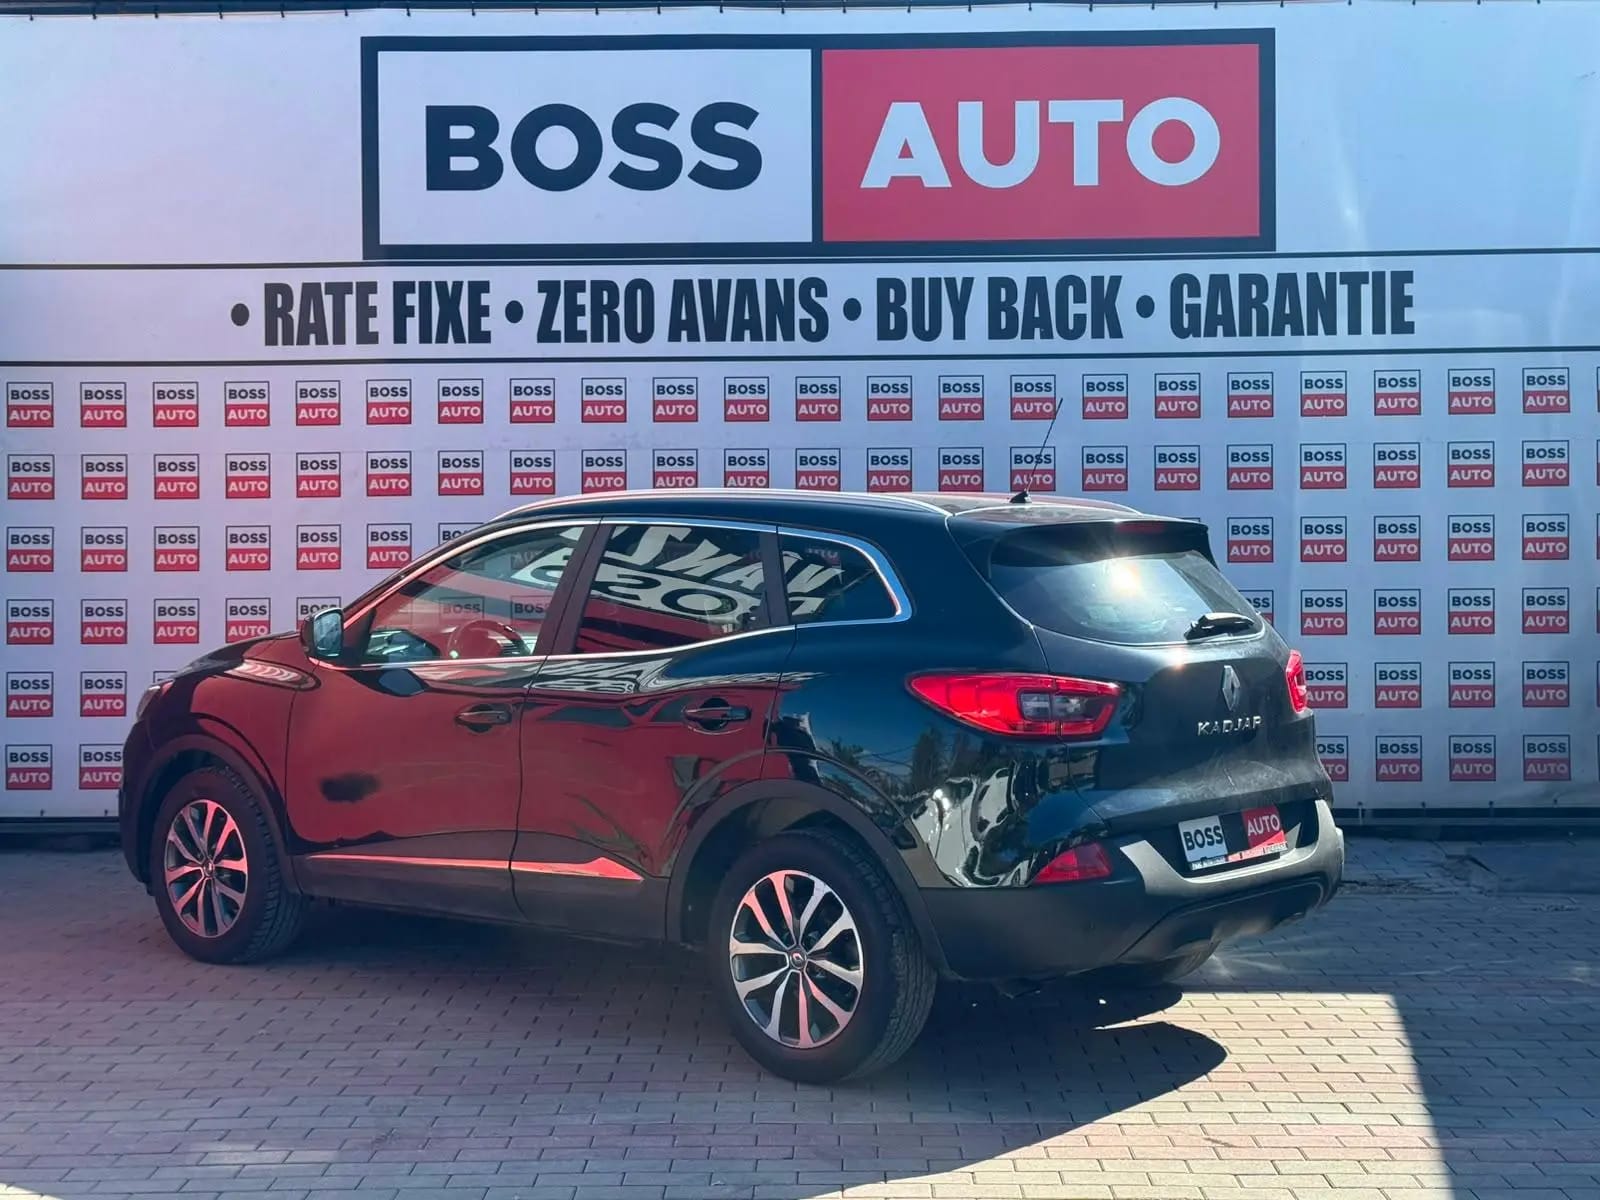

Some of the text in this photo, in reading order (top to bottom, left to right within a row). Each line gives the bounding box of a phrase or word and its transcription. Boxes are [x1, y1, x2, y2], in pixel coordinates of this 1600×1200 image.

[425, 96, 1221, 192] BOSS AUTO
[263, 270, 1416, 347] RATE FIXE ZERO AVANS BUY BACK GARANTIE
[1014, 381, 1053, 393] BOSS
[1086, 381, 1125, 393] BOSS
[1158, 380, 1197, 392] BOSS
[1231, 379, 1270, 391] BOSS
[1304, 378, 1343, 390] BOSS
[1378, 377, 1417, 389] BOSS
[1452, 376, 1491, 388] BOSS
[1527, 375, 1566, 387] BOSS
[228, 388, 267, 400] BOSS
[299, 387, 338, 399] BOSS
[370, 386, 409, 398] BOSS
[441, 385, 480, 397] BOSS
[513, 385, 552, 397] BOSS
[585, 384, 624, 396] BOSS
[656, 384, 695, 396] BOSS
[727, 383, 766, 395] BOSS
[799, 383, 838, 395] BOSS
[870, 382, 909, 394] BOSS
[942, 382, 981, 394] BOSS
[11, 389, 50, 401] BOSS
[84, 389, 123, 401] BOSS
[156, 389, 195, 401] BOSS
[1526, 395, 1567, 407] AUTO
[869, 402, 910, 414] AUTO
[941, 402, 982, 414] AUTO
[1013, 401, 1054, 413] AUTO
[1085, 401, 1126, 413] AUTO
[1157, 400, 1198, 412] AUTO
[1230, 399, 1271, 411] AUTO
[1303, 398, 1344, 410] AUTO
[1377, 397, 1418, 409] AUTO
[1451, 396, 1492, 408] AUTO
[10, 409, 51, 421] AUTO
[83, 409, 124, 421] AUTO
[155, 409, 196, 421] AUTO
[227, 408, 268, 420] AUTO
[298, 407, 339, 419] AUTO
[369, 406, 410, 418] AUTO
[440, 405, 481, 417] AUTO
[512, 405, 553, 417] AUTO
[584, 404, 625, 416] AUTO
[655, 404, 696, 416] AUTO
[726, 403, 767, 415] AUTO
[798, 403, 839, 415] AUTO
[1086, 453, 1125, 465] BOSS
[1158, 452, 1197, 464] BOSS
[1231, 451, 1270, 463] BOSS
[1304, 450, 1343, 462] BOSS
[1378, 450, 1417, 462] BOSS
[1452, 449, 1491, 461] BOSS
[1526, 447, 1565, 459] BOSS
[229, 460, 268, 472] BOSS
[299, 459, 338, 471] BOSS
[370, 458, 409, 470] BOSS
[442, 457, 481, 469] BOSS
[513, 456, 552, 468] BOSS
[585, 456, 624, 468] BOSS
[656, 455, 695, 467] BOSS
[727, 455, 766, 467] BOSS
[799, 455, 838, 467] BOSS
[870, 454, 909, 466] BOSS
[942, 454, 981, 466] BOSS
[12, 461, 51, 473] BOSS
[85, 461, 124, 473] BOSS
[157, 461, 196, 473] BOSS
[1525, 467, 1566, 479] AUTO
[869, 474, 910, 486] AUTO
[941, 474, 982, 486] AUTO
[1085, 473, 1126, 485] AUTO
[1157, 472, 1198, 484] AUTO
[1230, 471, 1271, 483] AUTO
[1303, 470, 1344, 482] AUTO
[1377, 470, 1418, 482] AUTO
[1451, 469, 1492, 481] AUTO
[11, 481, 52, 493] AUTO
[84, 481, 125, 493] AUTO
[156, 481, 197, 493] AUTO
[228, 480, 269, 492] AUTO
[298, 479, 339, 491] AUTO
[369, 478, 410, 490] AUTO
[441, 477, 482, 489] AUTO
[512, 476, 553, 488] AUTO
[584, 476, 625, 488] AUTO
[1231, 524, 1270, 536] BOSS
[1304, 523, 1343, 535] BOSS
[1378, 523, 1417, 535] BOSS
[1452, 522, 1491, 534] BOSS
[1526, 521, 1565, 533] BOSS
[11, 534, 50, 546] BOSS
[85, 533, 124, 545] BOSS
[158, 533, 197, 545] BOSS
[229, 532, 268, 544] BOSS
[300, 531, 339, 543] BOSS
[370, 530, 409, 542] BOSS
[1230, 544, 1271, 556] AUTO
[1303, 543, 1344, 555] AUTO
[1377, 543, 1418, 555] AUTO
[1451, 542, 1492, 554] AUTO
[1525, 541, 1566, 553] AUTO
[10, 554, 51, 566] AUTO
[84, 553, 125, 565] AUTO
[157, 553, 198, 565] AUTO
[228, 552, 269, 564] AUTO
[299, 551, 340, 563] AUTO
[369, 550, 410, 562] AUTO
[1305, 597, 1344, 609] BOSS
[1378, 596, 1417, 608] BOSS
[1452, 595, 1491, 607] BOSS
[1526, 595, 1565, 607] BOSS
[11, 606, 50, 618] BOSS
[85, 606, 124, 618] BOSS
[157, 605, 196, 617] BOSS
[229, 605, 268, 617] BOSS
[1304, 617, 1345, 629] AUTO
[1377, 616, 1418, 628] AUTO
[1451, 615, 1492, 627] AUTO
[1525, 615, 1566, 627] AUTO
[10, 626, 51, 638] AUTO
[84, 626, 125, 638] AUTO
[156, 625, 197, 637] AUTO
[1379, 669, 1418, 681] BOSS
[1452, 669, 1491, 681] BOSS
[1526, 668, 1565, 680] BOSS
[10, 679, 49, 691] BOSS
[84, 678, 123, 690] BOSS
[1378, 689, 1419, 701] AUTO
[1451, 689, 1492, 701] AUTO
[1525, 688, 1566, 700] AUTO
[9, 699, 50, 711] AUTO
[83, 698, 124, 710] AUTO
[1197, 715, 1263, 736] KADJAR
[1380, 743, 1419, 755] BOSS
[1453, 742, 1492, 754] BOSS
[1527, 742, 1566, 754] BOSS
[10, 751, 49, 763] BOSS
[1379, 763, 1420, 775] AUTO
[1452, 762, 1493, 774] AUTO
[1526, 762, 1567, 774] AUTO
[9, 771, 50, 783] AUTO
[1183, 813, 1281, 851] BOSS AUTO
